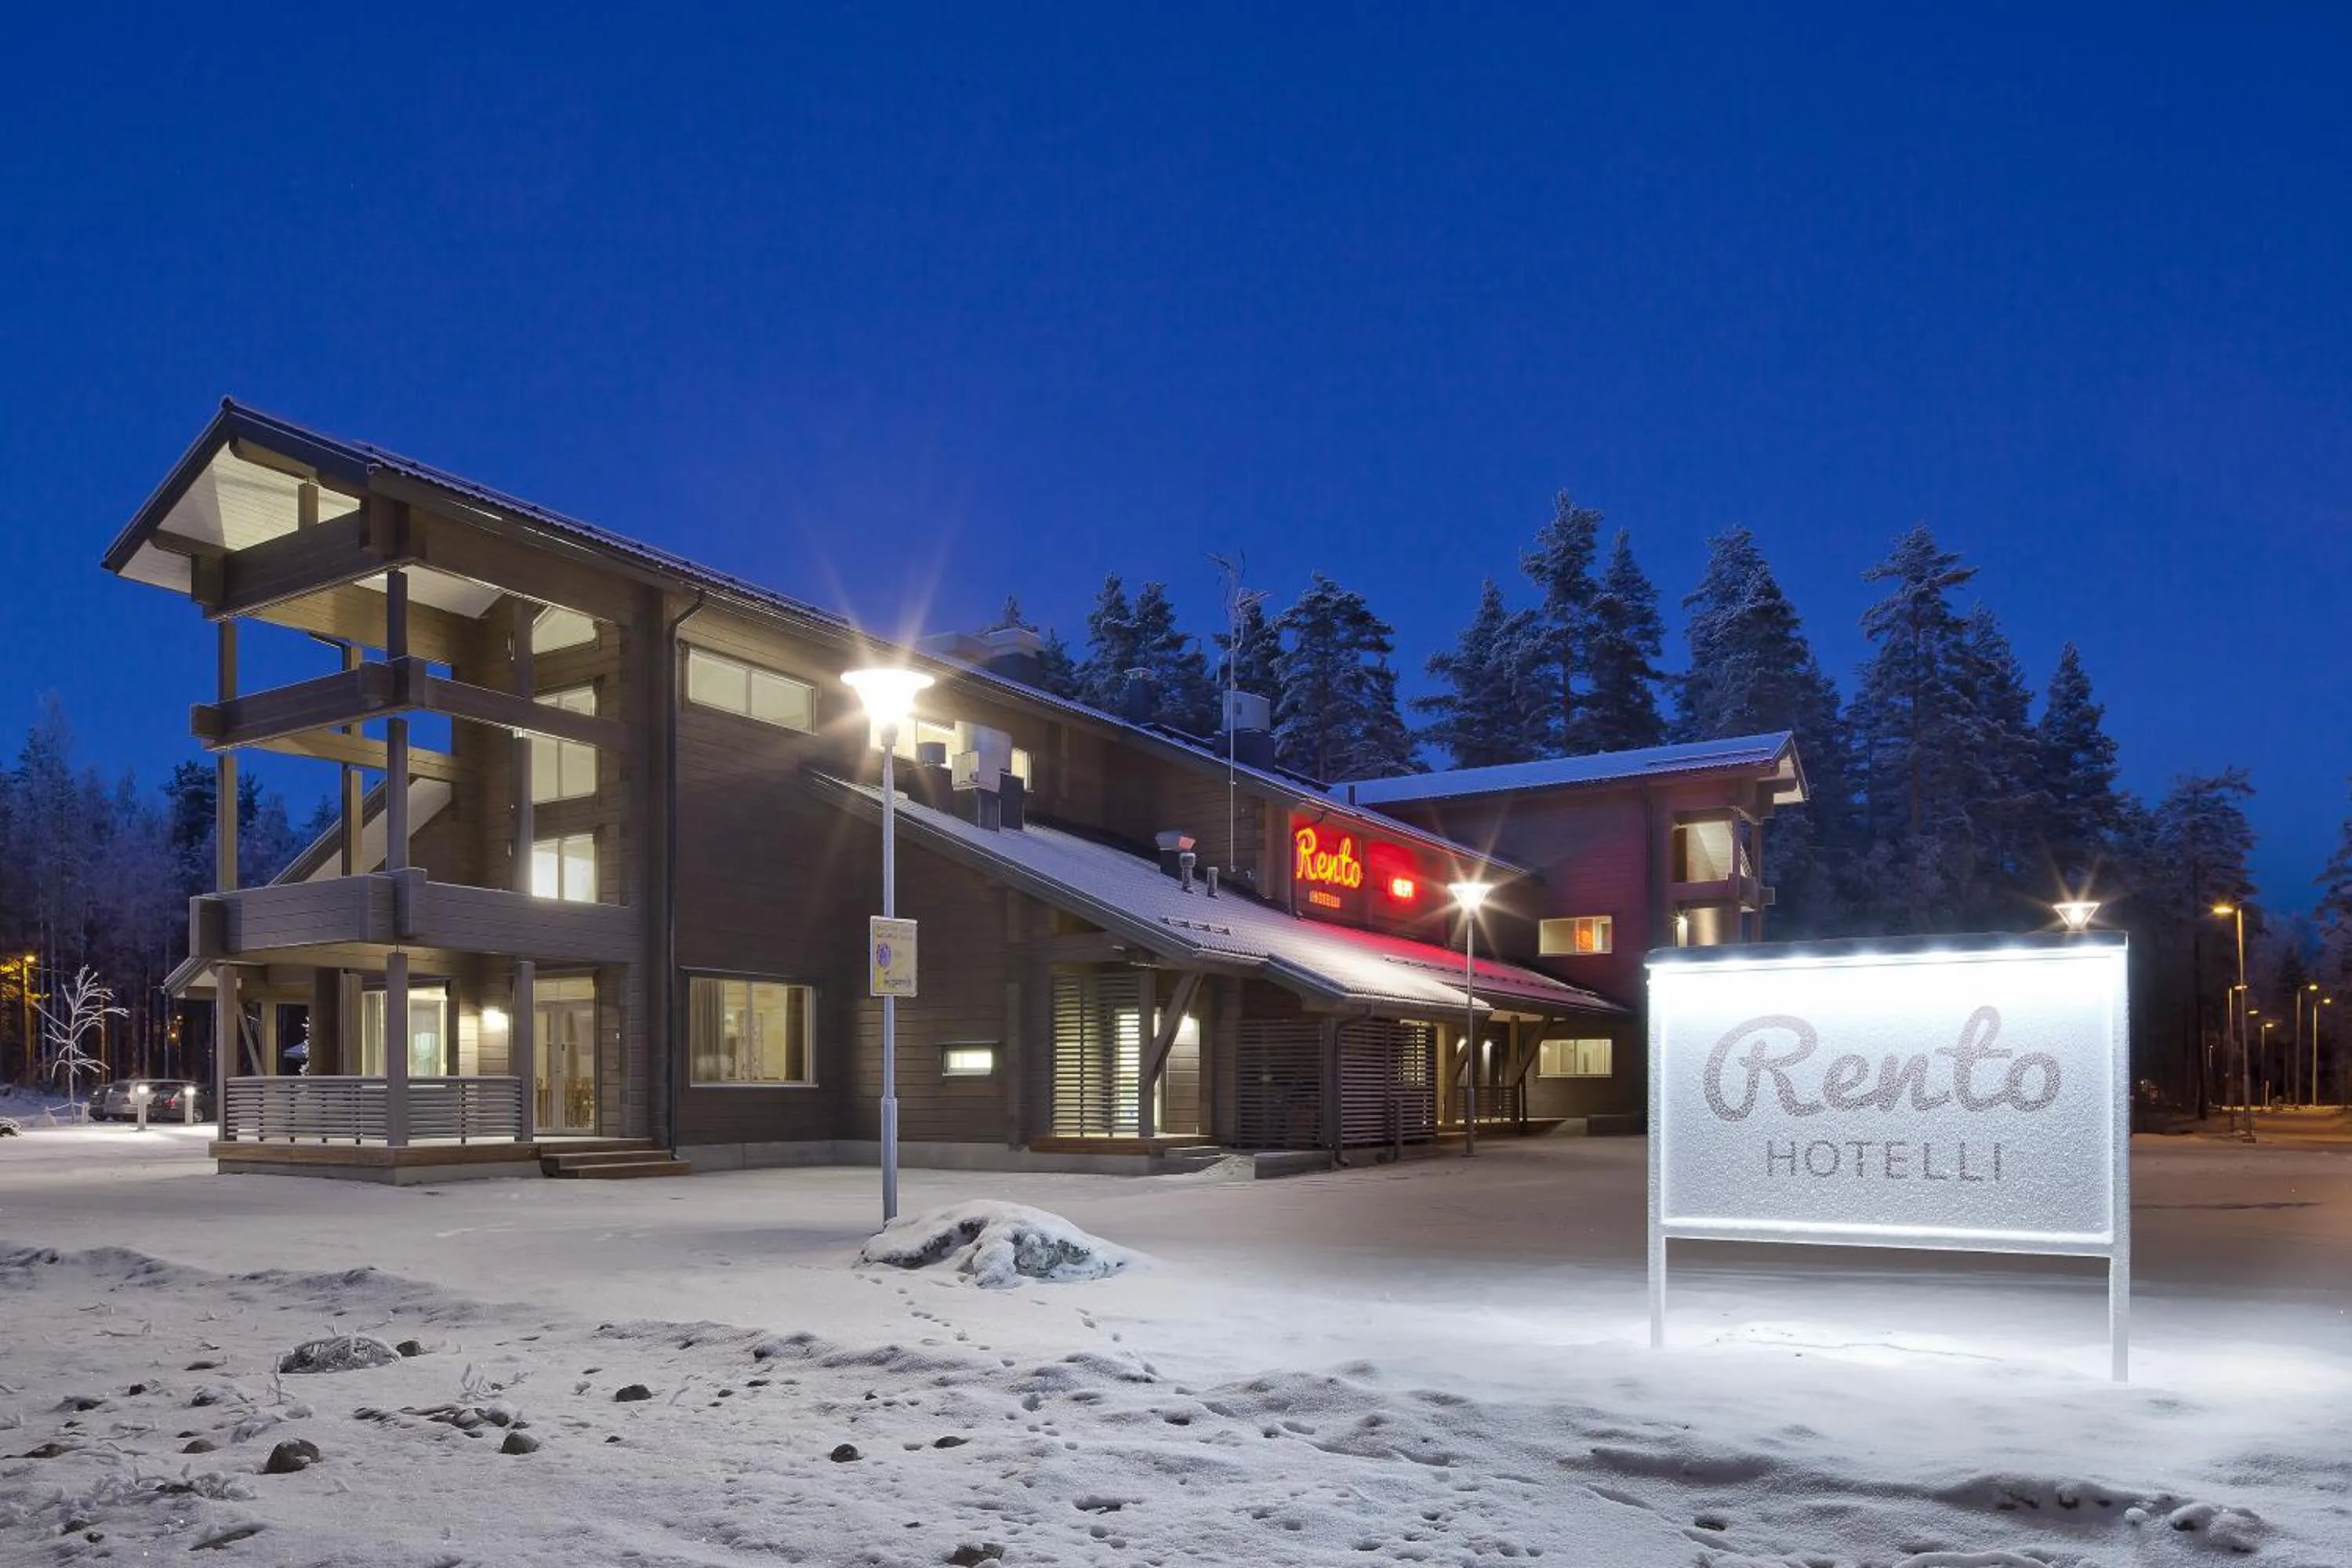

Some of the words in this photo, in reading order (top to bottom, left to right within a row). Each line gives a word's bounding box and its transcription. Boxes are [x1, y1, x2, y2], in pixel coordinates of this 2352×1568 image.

[1296, 827, 1361, 888] Rento
[1703, 1005, 2062, 1122] Rento
[1766, 1140, 2002, 1181] HOTELLI
